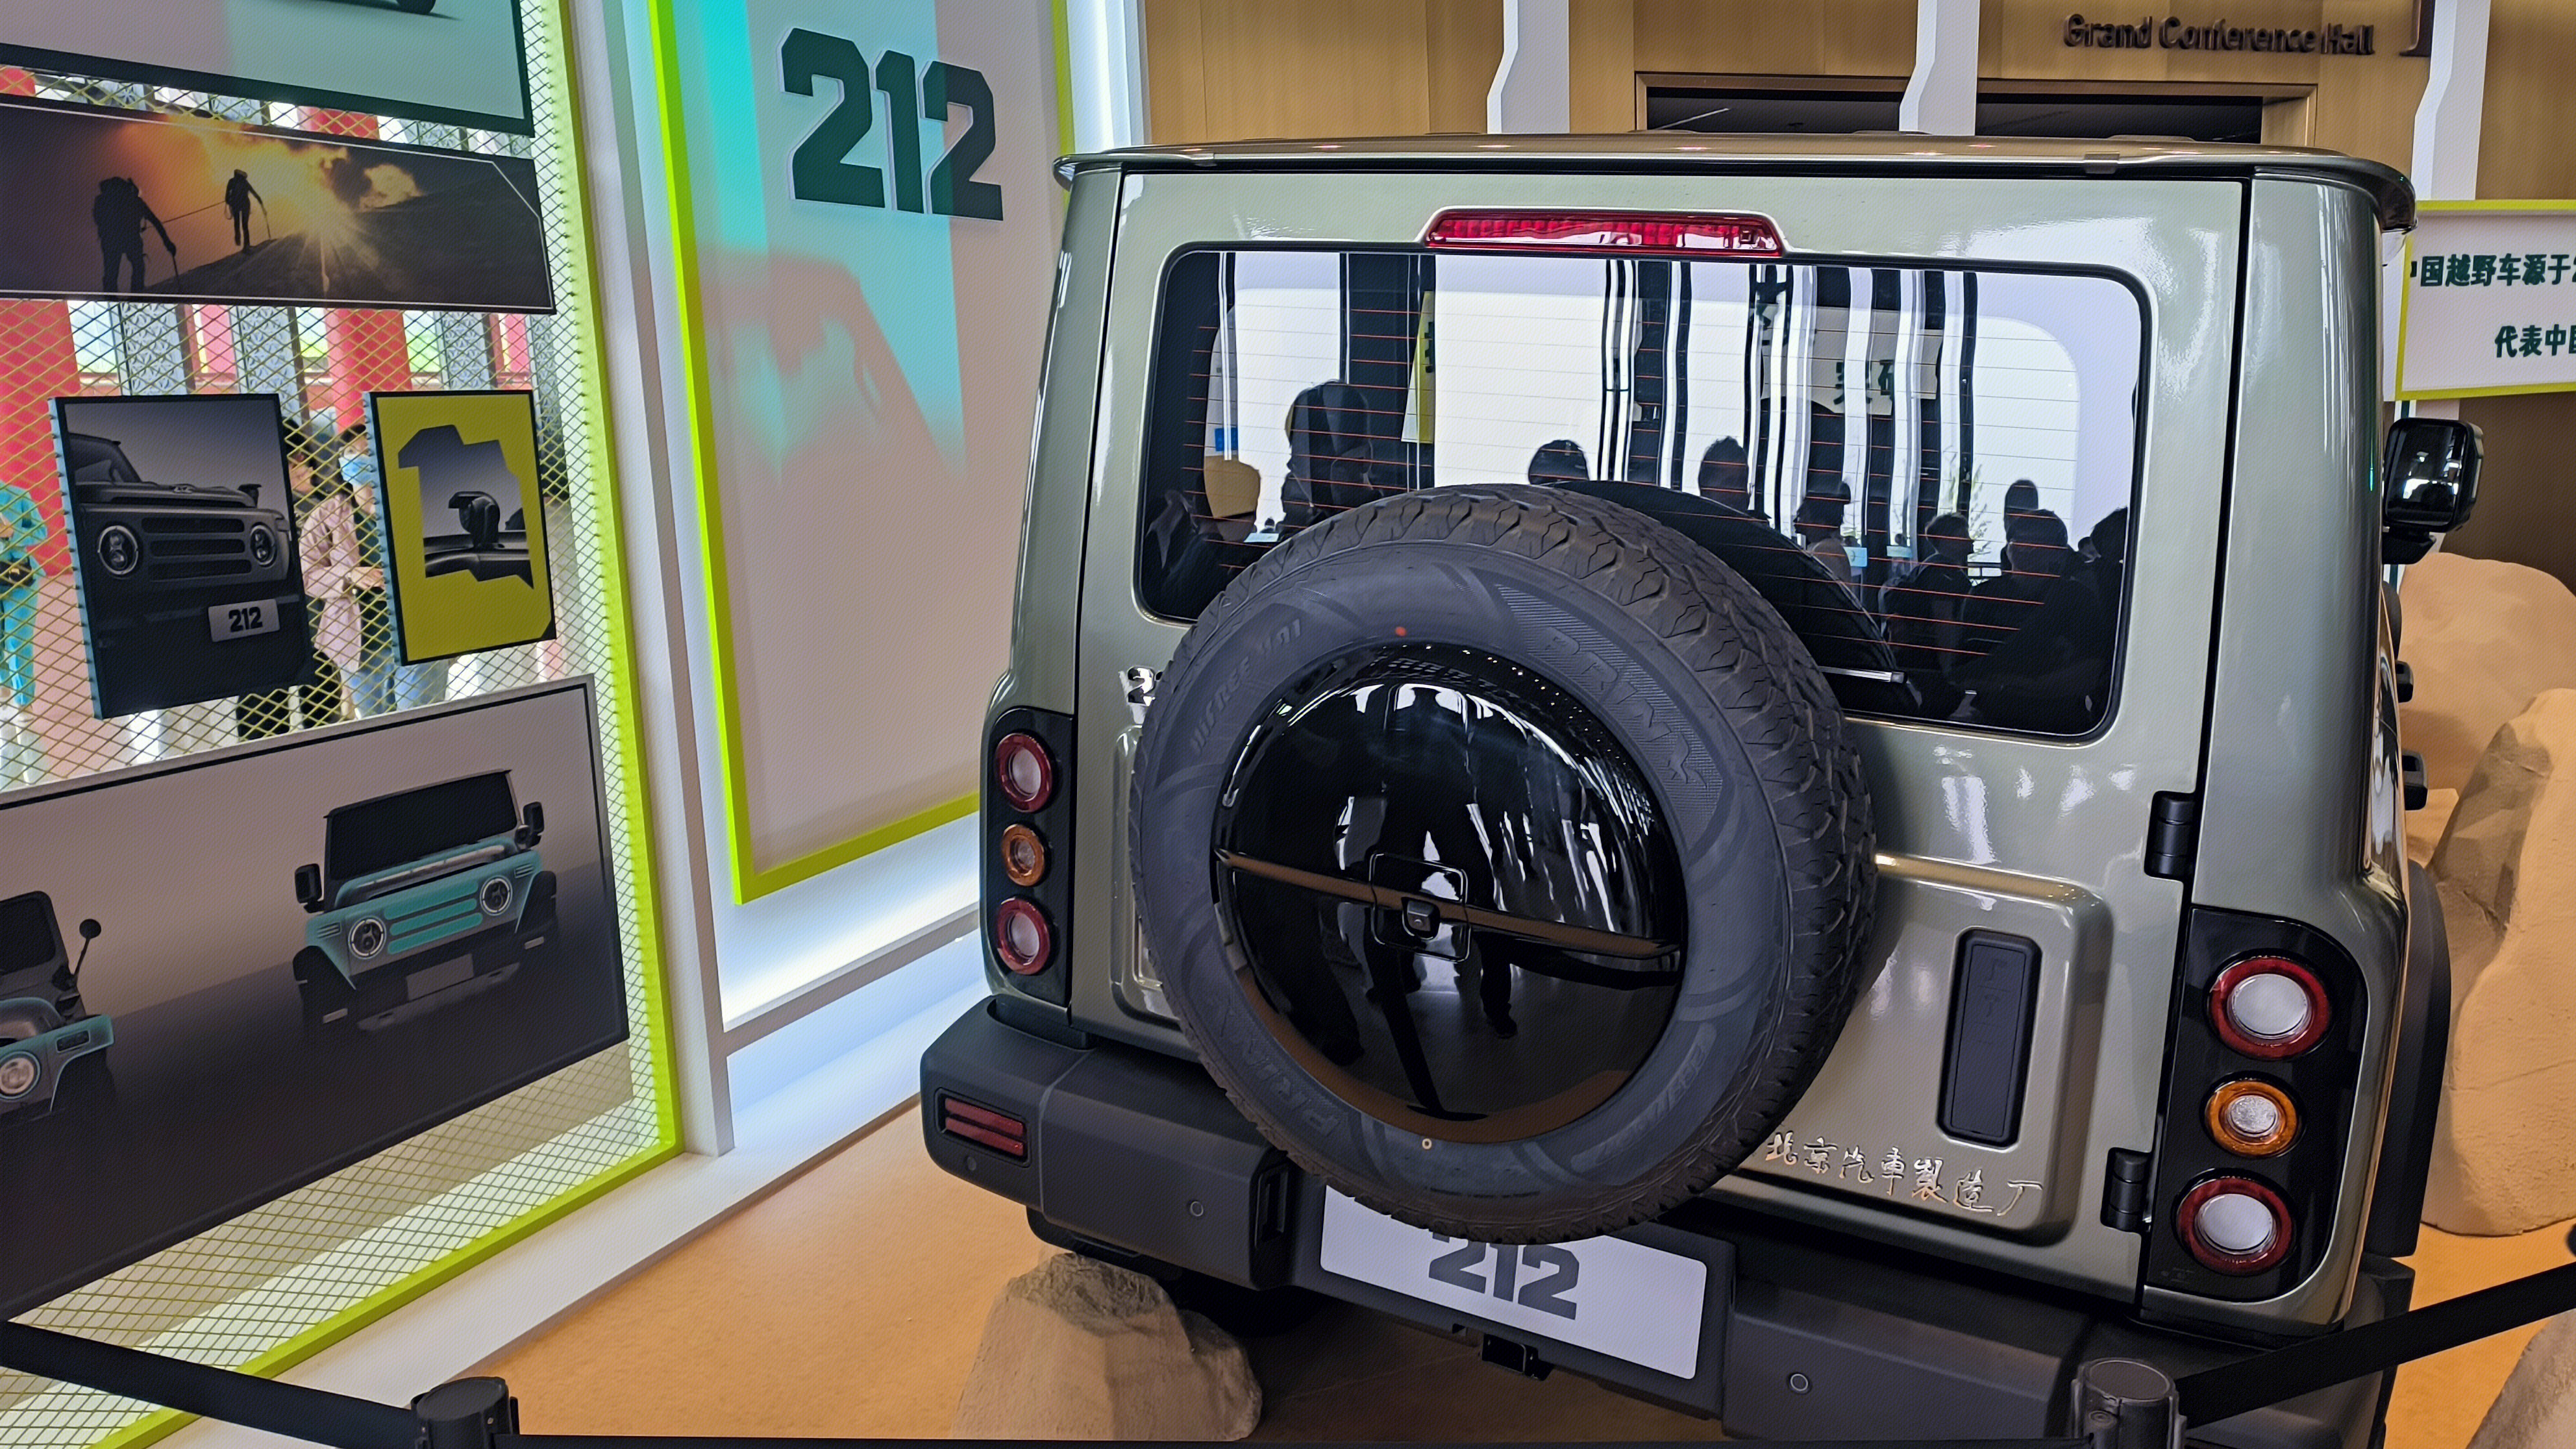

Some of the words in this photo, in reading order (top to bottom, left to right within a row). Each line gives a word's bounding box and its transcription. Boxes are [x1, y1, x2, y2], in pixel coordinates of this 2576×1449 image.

[2063, 13, 2153, 47] Grand
[2159, 16, 2317, 53] Conference
[2320, 22, 2375, 55] Hall
[777, 27, 1004, 221] 212
[2410, 253, 2576, 287] 国越野车源于
[229, 606, 263, 632] 212
[1428, 1232, 1579, 1320] 212
